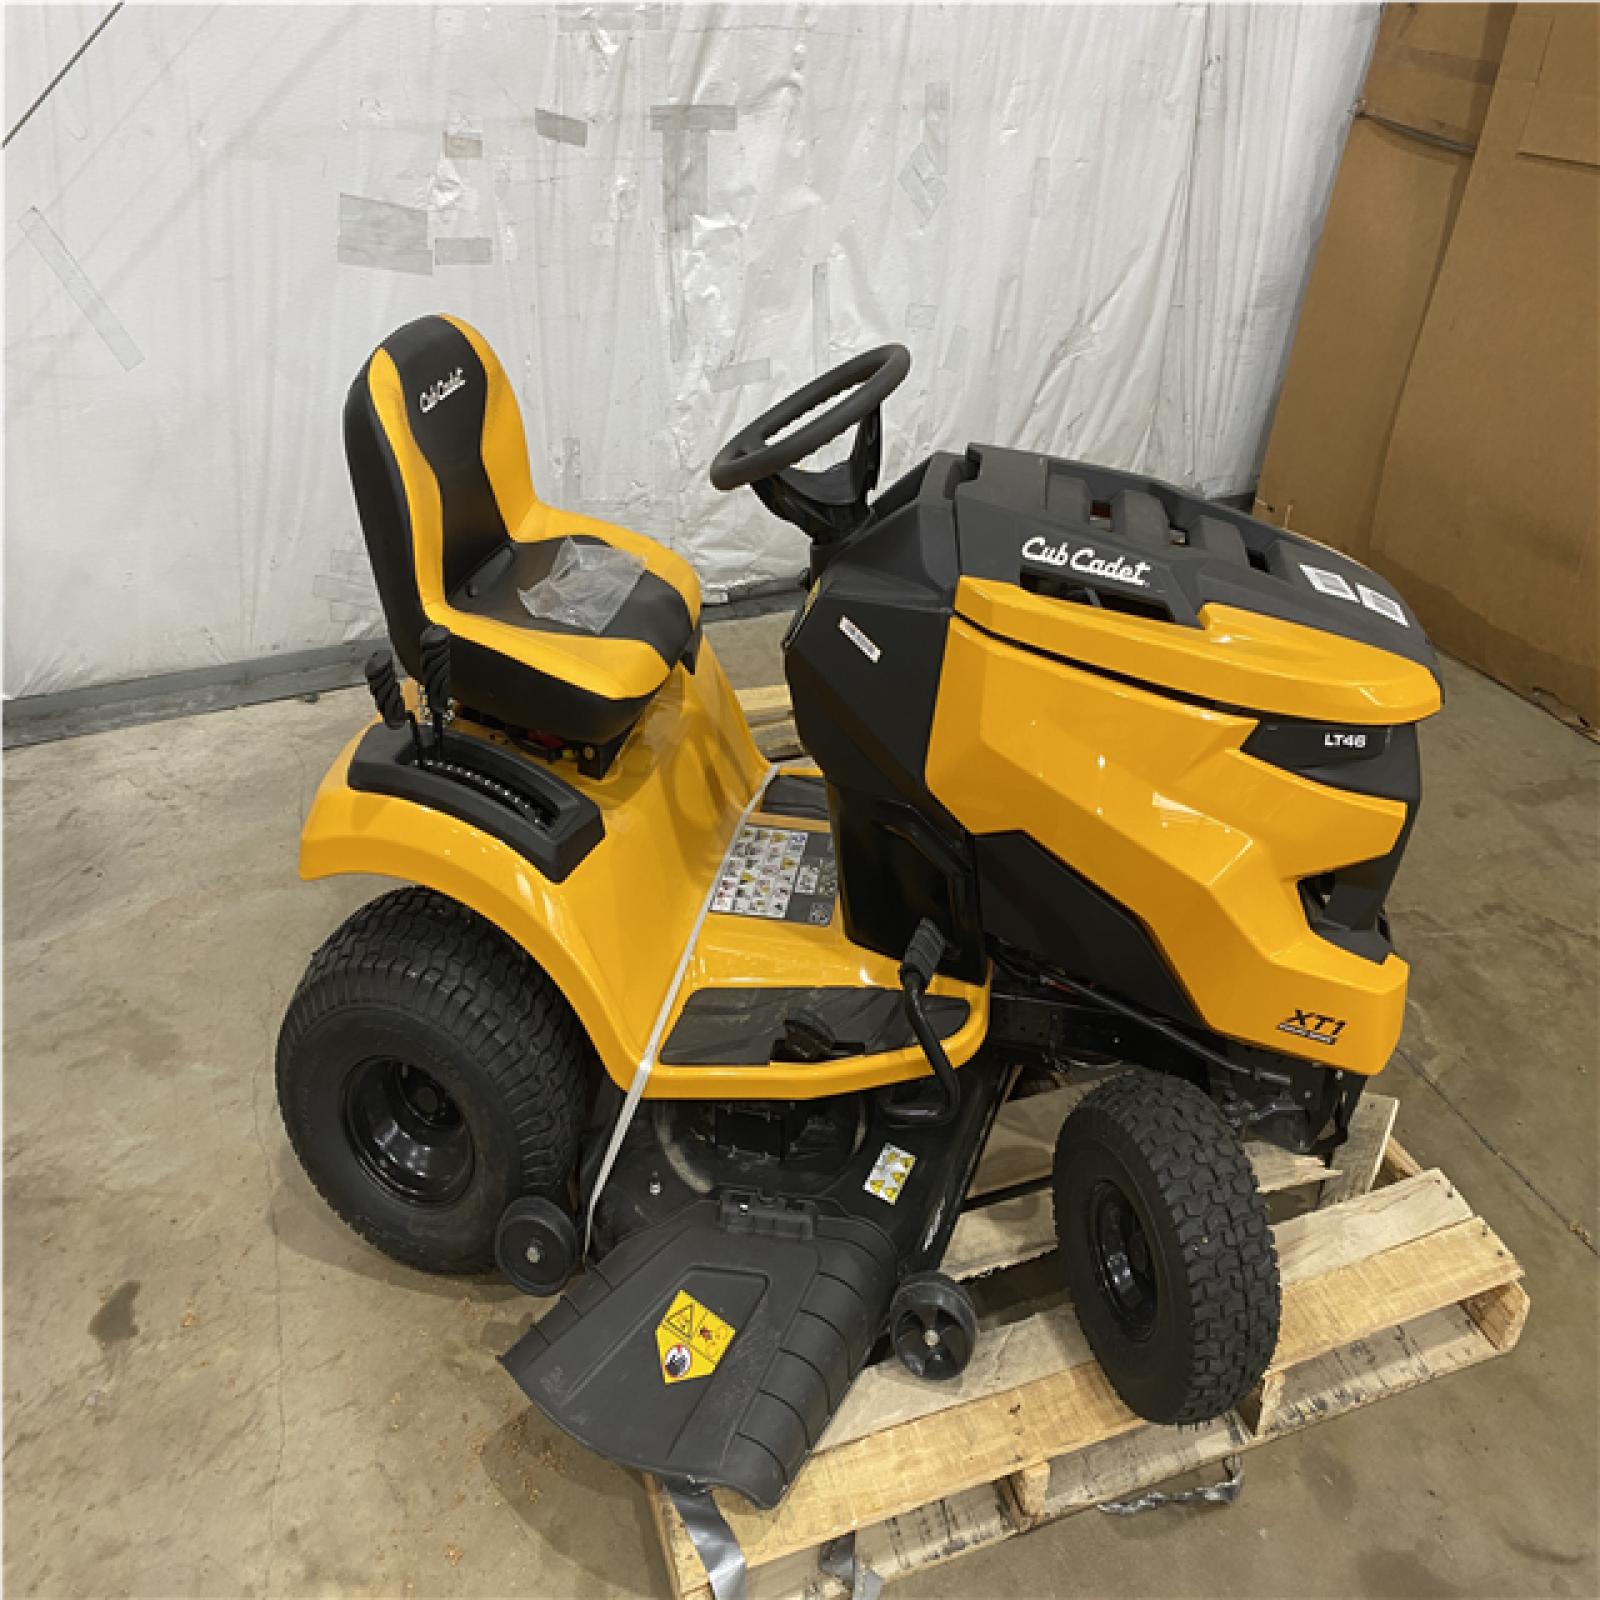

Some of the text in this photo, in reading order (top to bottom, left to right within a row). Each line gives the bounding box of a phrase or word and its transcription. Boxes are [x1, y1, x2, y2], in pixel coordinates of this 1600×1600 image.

[1021, 536, 1150, 586] Cub Cadet
[1284, 1008, 1346, 1036] XT1
